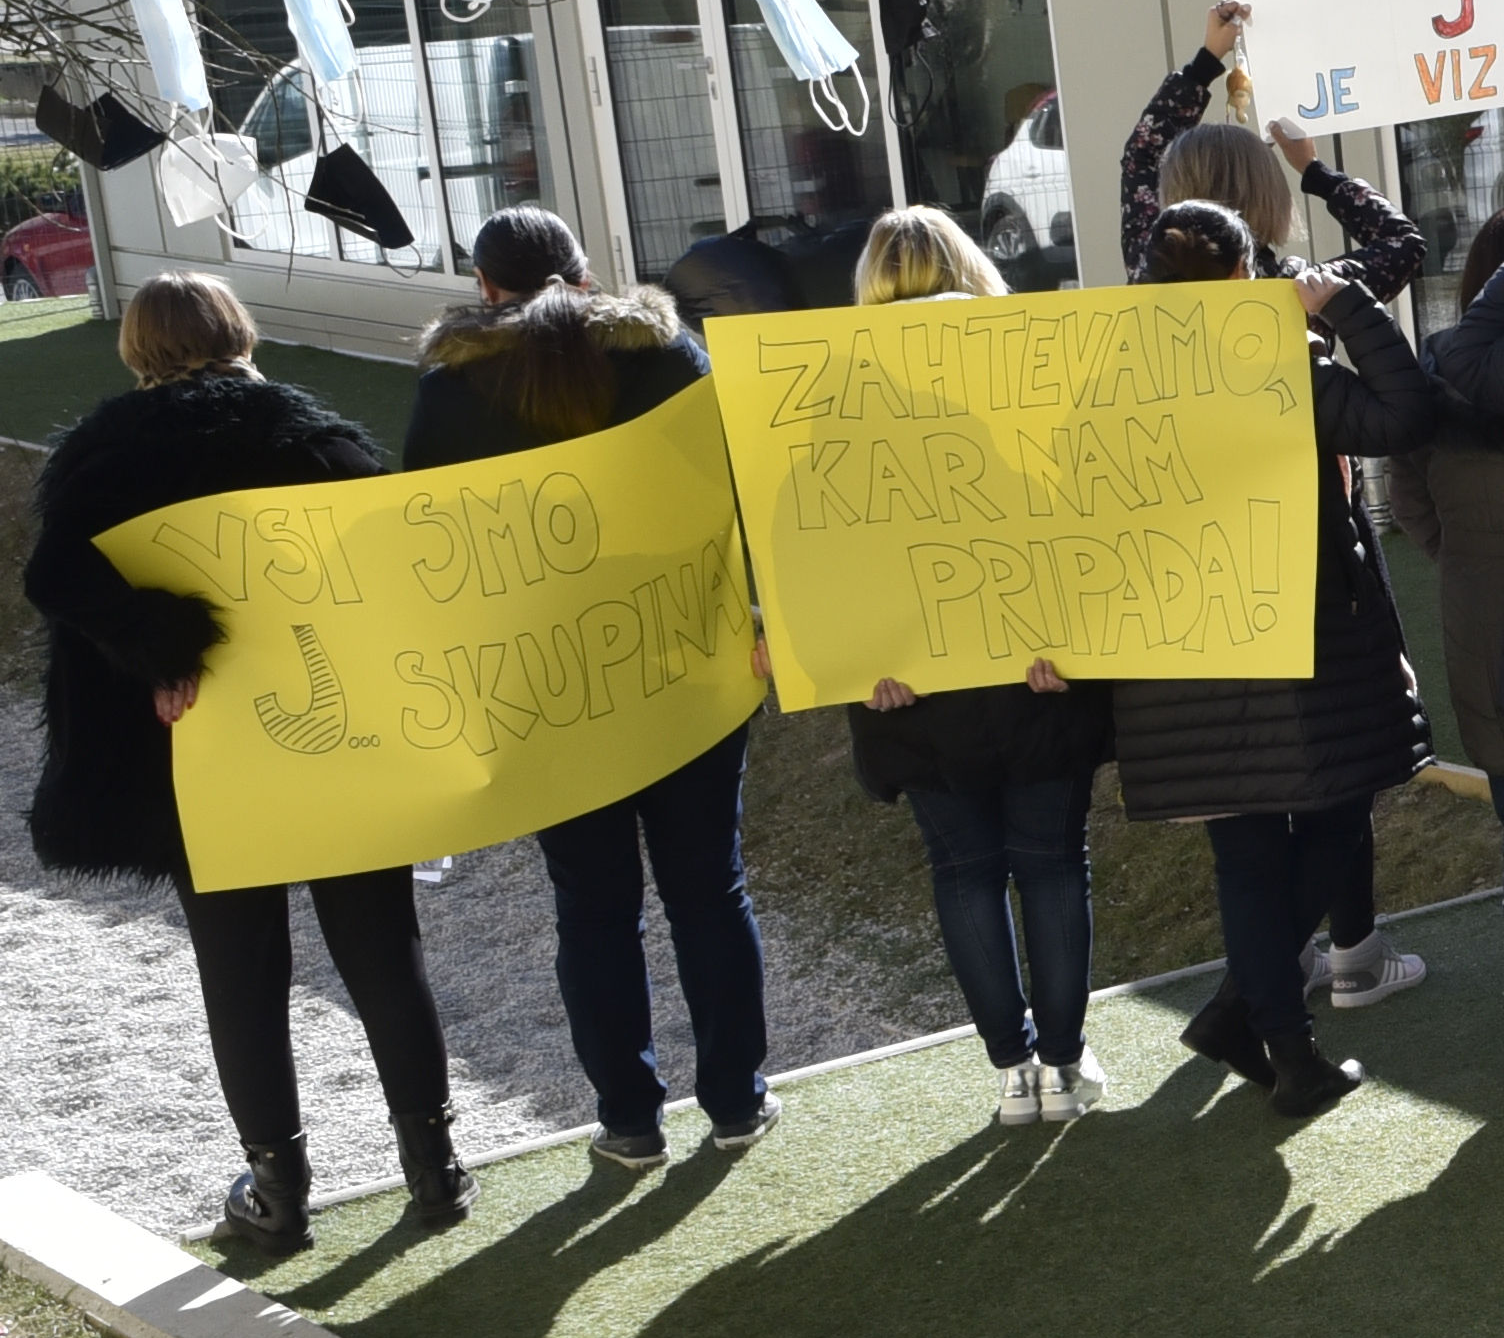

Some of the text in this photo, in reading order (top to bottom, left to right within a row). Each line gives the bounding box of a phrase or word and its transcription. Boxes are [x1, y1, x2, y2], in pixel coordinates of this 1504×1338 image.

[1297, 66, 1360, 120] JE
[1414, 44, 1498, 105] VIZ
[758, 300, 1297, 428] ZAHTEVAMO,
[788, 414, 1204, 530] KAR NAM
[153, 472, 600, 604] VSI SMO
[907, 498, 1281, 659] PRIPADA!
[394, 540, 747, 756] SKUPINA
